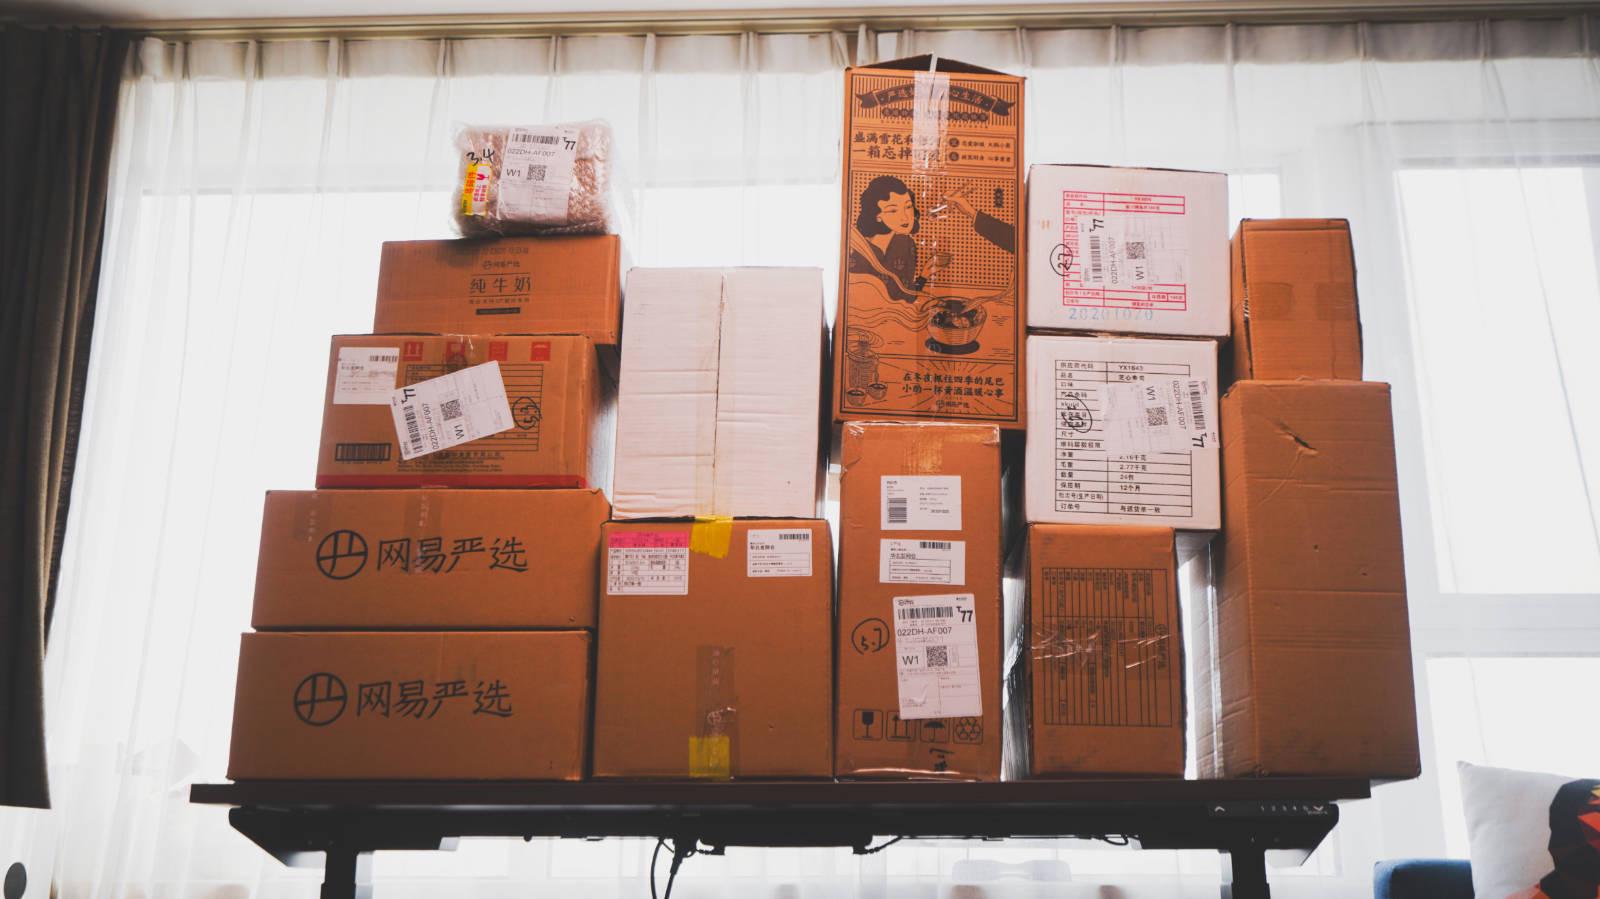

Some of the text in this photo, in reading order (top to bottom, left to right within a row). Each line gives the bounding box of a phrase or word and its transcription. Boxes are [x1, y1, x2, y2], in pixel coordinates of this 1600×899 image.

[506, 168, 521, 177] W1
[1135, 265, 1144, 280] W1
[470, 277, 531, 293] 纯牛奶
[1146, 385, 1156, 400] W1
[454, 424, 464, 440] W1
[376, 536, 529, 573] 网易严选
[897, 627, 952, 637] 022DH-AF007
[902, 655, 919, 665] W1
[356, 679, 513, 719] 网易严选
